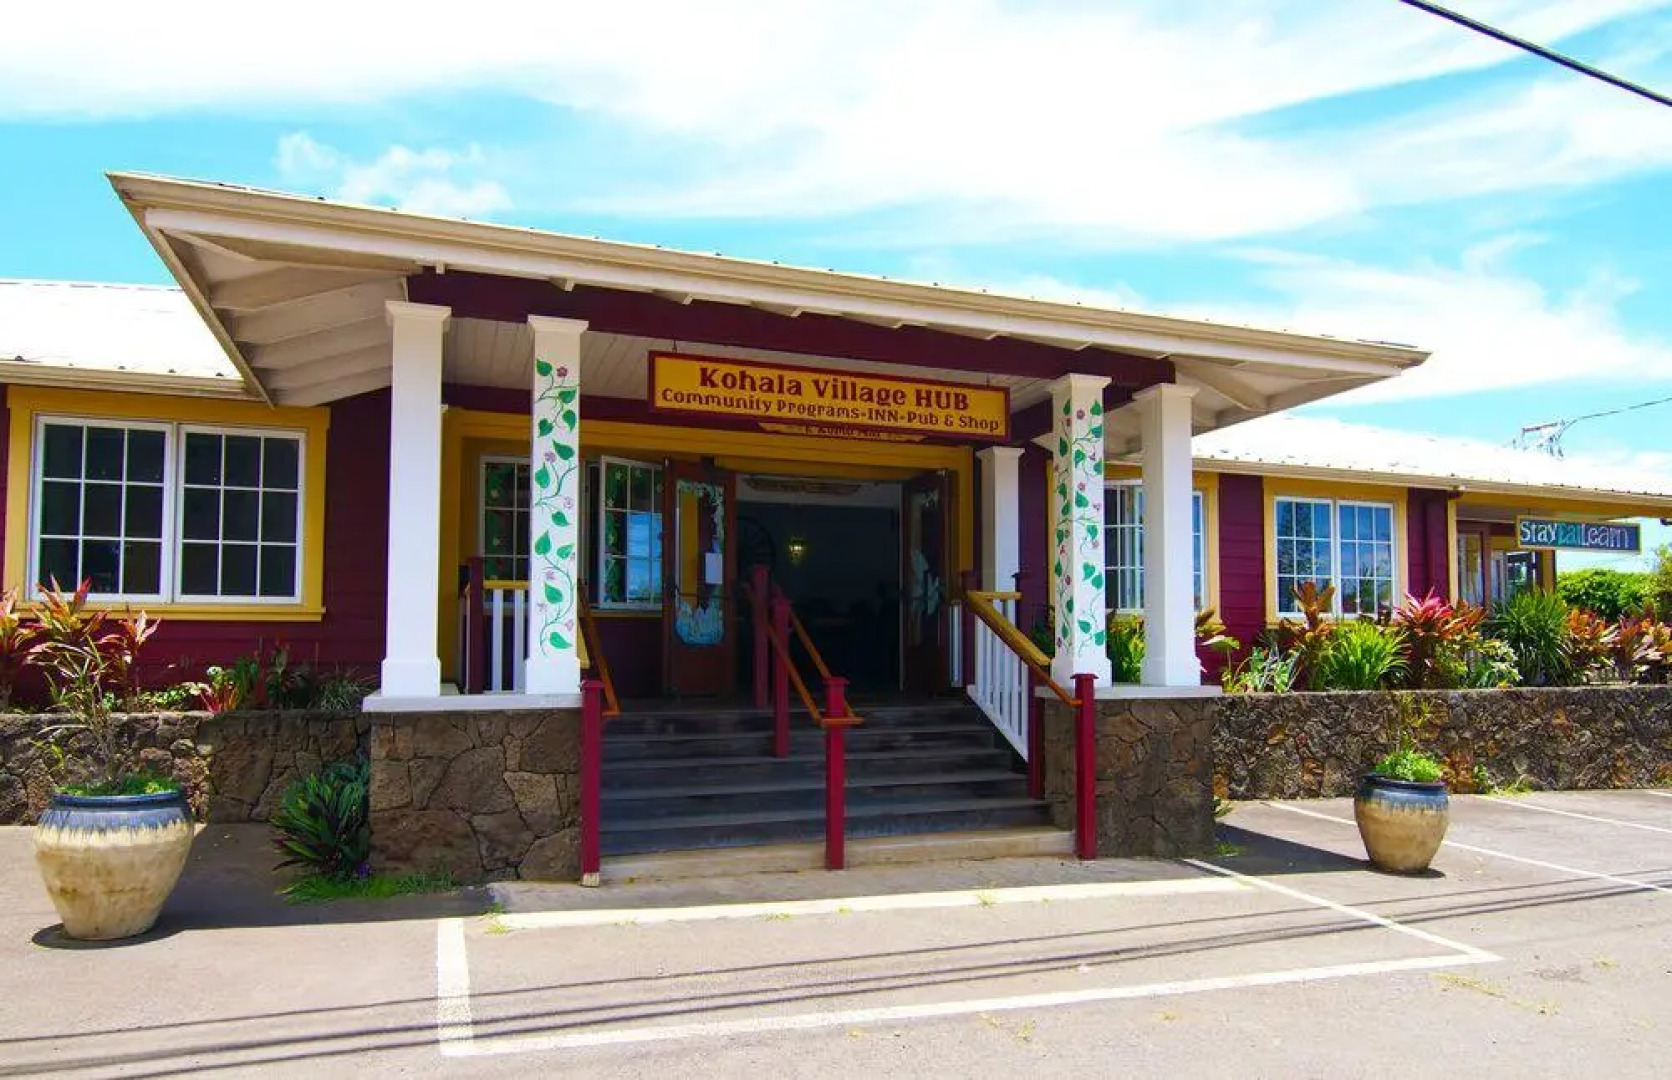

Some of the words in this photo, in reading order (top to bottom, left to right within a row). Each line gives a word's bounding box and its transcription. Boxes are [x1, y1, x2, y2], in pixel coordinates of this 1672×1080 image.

[661, 388, 772, 412] Community
[944, 416, 954, 427] &
[958, 415, 1000, 432] Shop
[699, 367, 803, 396] Kohala
[812, 378, 906, 405] Village
[915, 388, 969, 410] HUB
